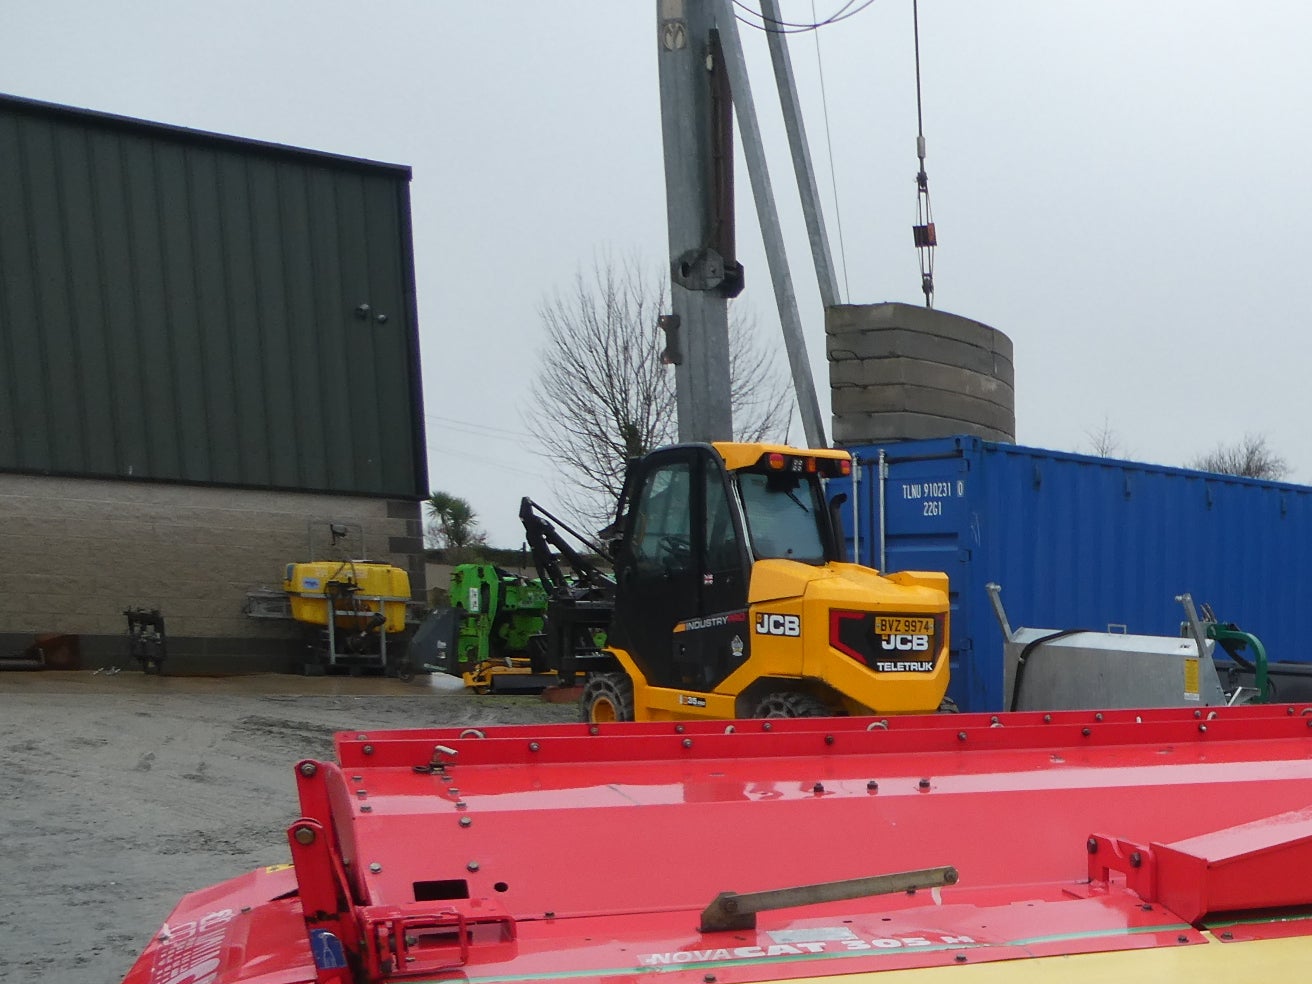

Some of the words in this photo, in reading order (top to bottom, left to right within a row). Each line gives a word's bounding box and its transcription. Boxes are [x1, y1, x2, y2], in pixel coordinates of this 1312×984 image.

[902, 484, 922, 499] TLNU
[923, 482, 952, 498] 910231
[923, 501, 942, 516] 22G1
[686, 615, 729, 631] INDUSTRY
[756, 614, 800, 636] JCB
[880, 618, 902, 632] BVZ
[904, 620, 930, 633] 9974
[881, 634, 929, 651] JCB
[877, 661, 933, 671] TELETRUK
[841, 936, 930, 950] 305
